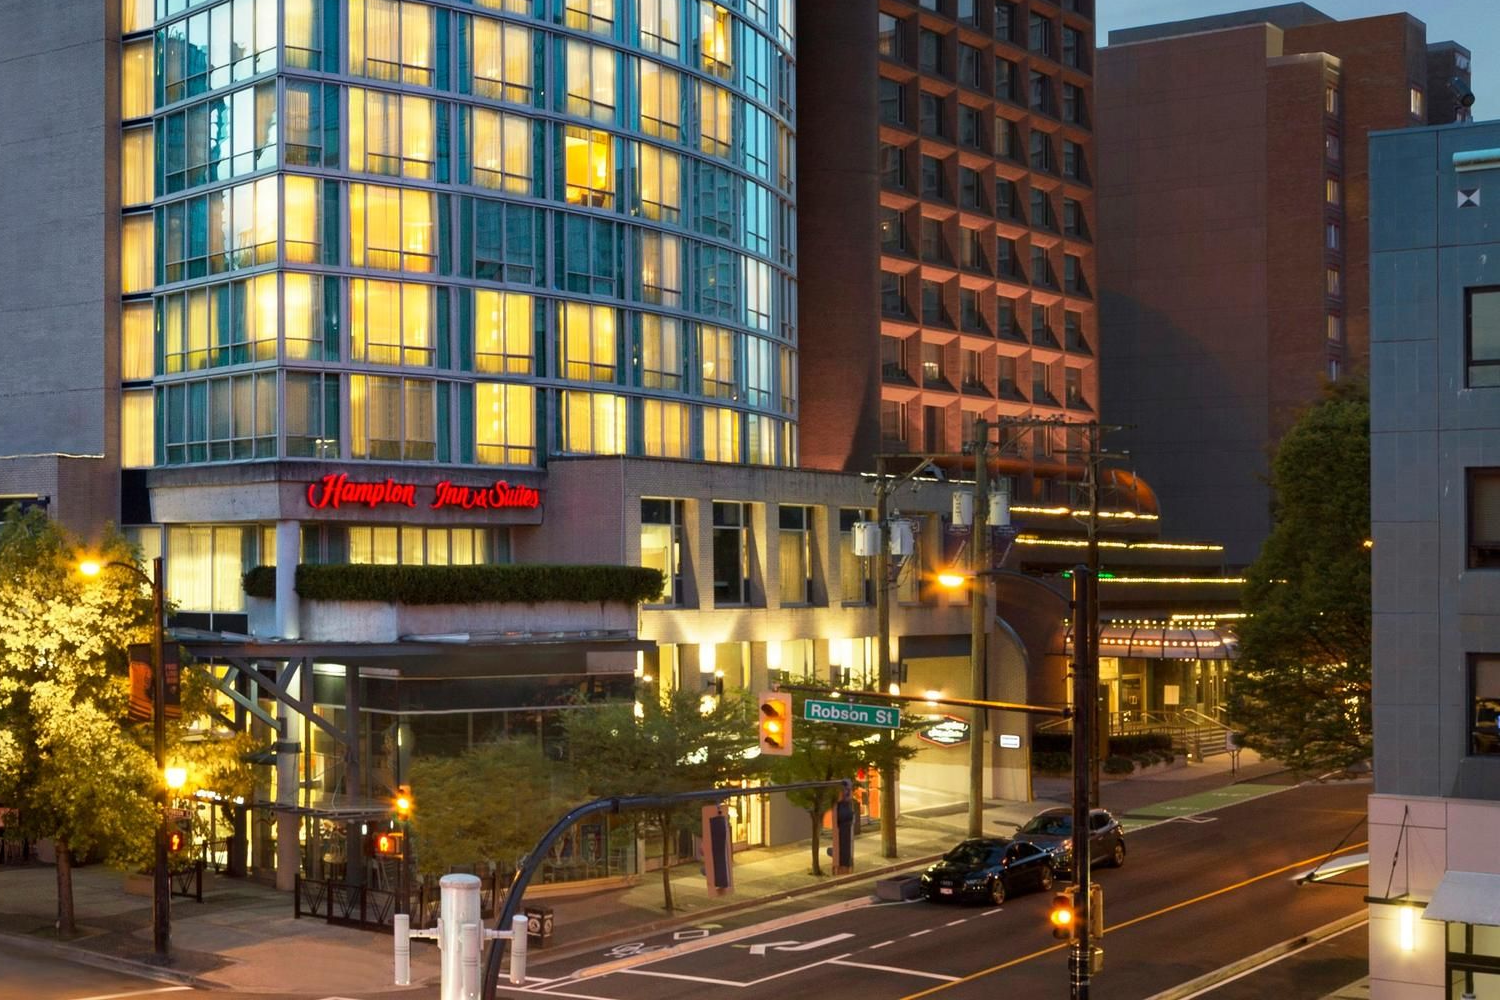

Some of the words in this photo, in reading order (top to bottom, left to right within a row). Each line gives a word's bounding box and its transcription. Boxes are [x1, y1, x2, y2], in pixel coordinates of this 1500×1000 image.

[308, 473, 417, 510] Hampton
[430, 480, 478, 510] Inn
[488, 480, 540, 509] Suites
[810, 703, 869, 723] Robson
[875, 709, 893, 725] St
